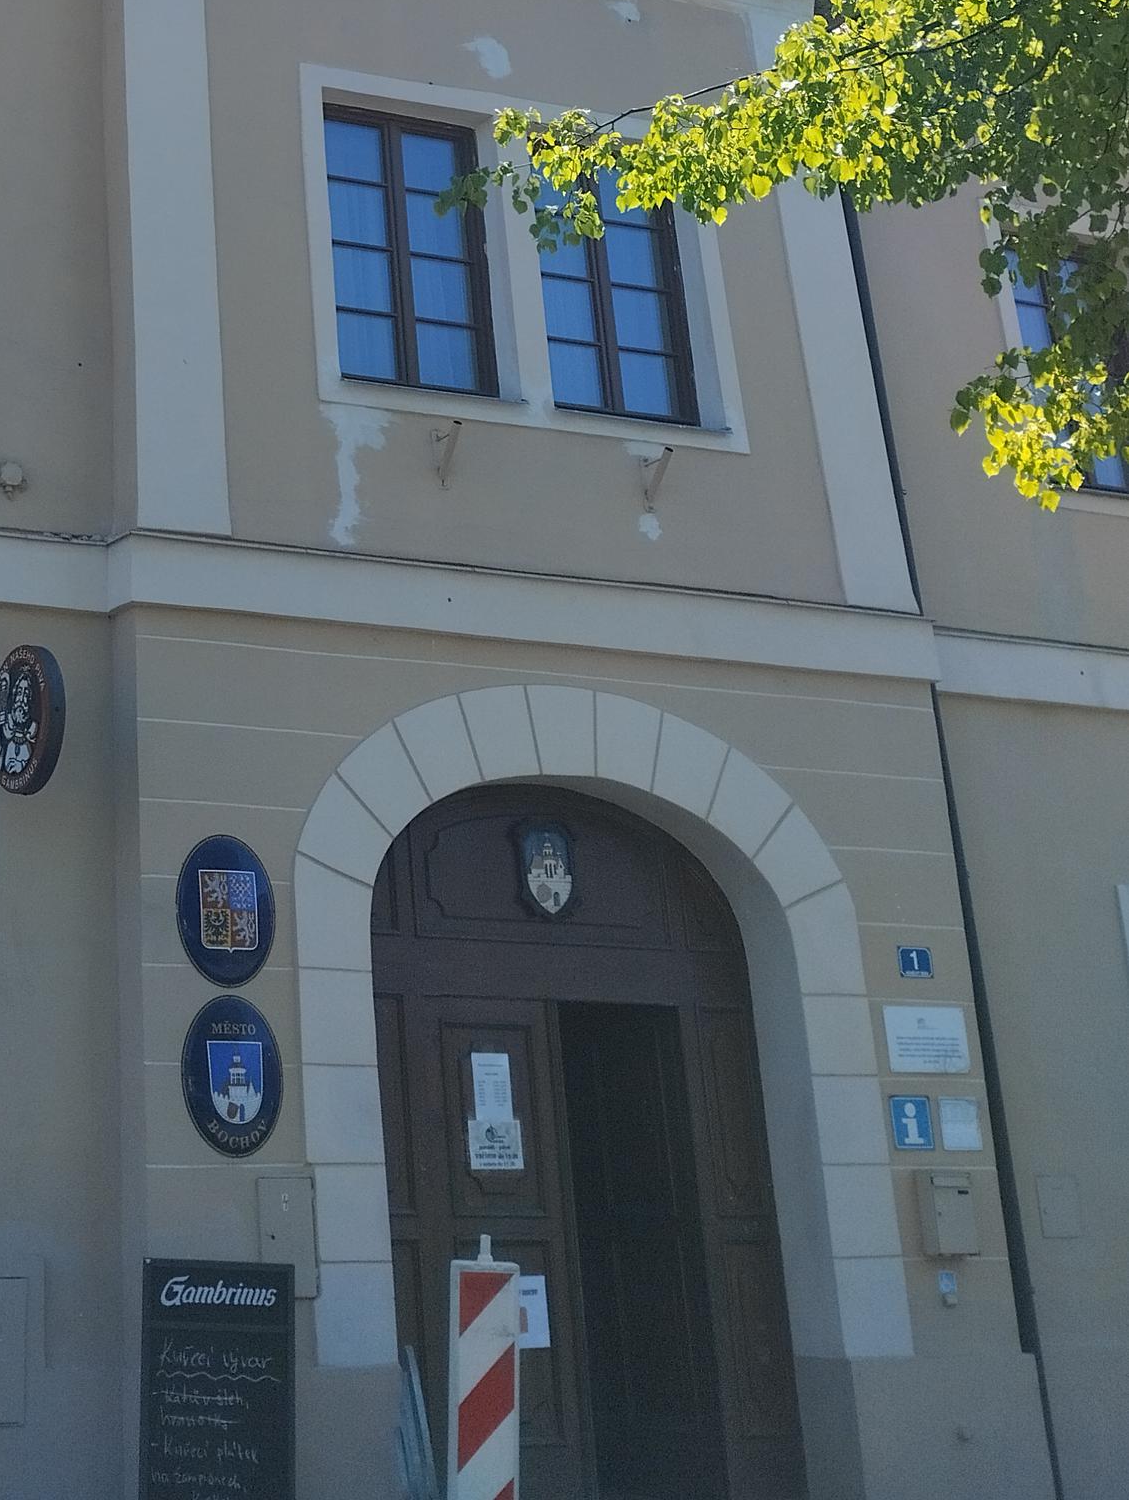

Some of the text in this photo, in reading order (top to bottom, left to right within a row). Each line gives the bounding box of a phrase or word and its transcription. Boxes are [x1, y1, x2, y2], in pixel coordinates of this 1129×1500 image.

[1, 758, 38, 790] GAMBRINUS
[910, 950, 919, 970] 1
[211, 1019, 257, 1036] MĚSTO
[206, 1119, 268, 1149] BOCHOV
[159, 1274, 277, 1307] Gambrinus
